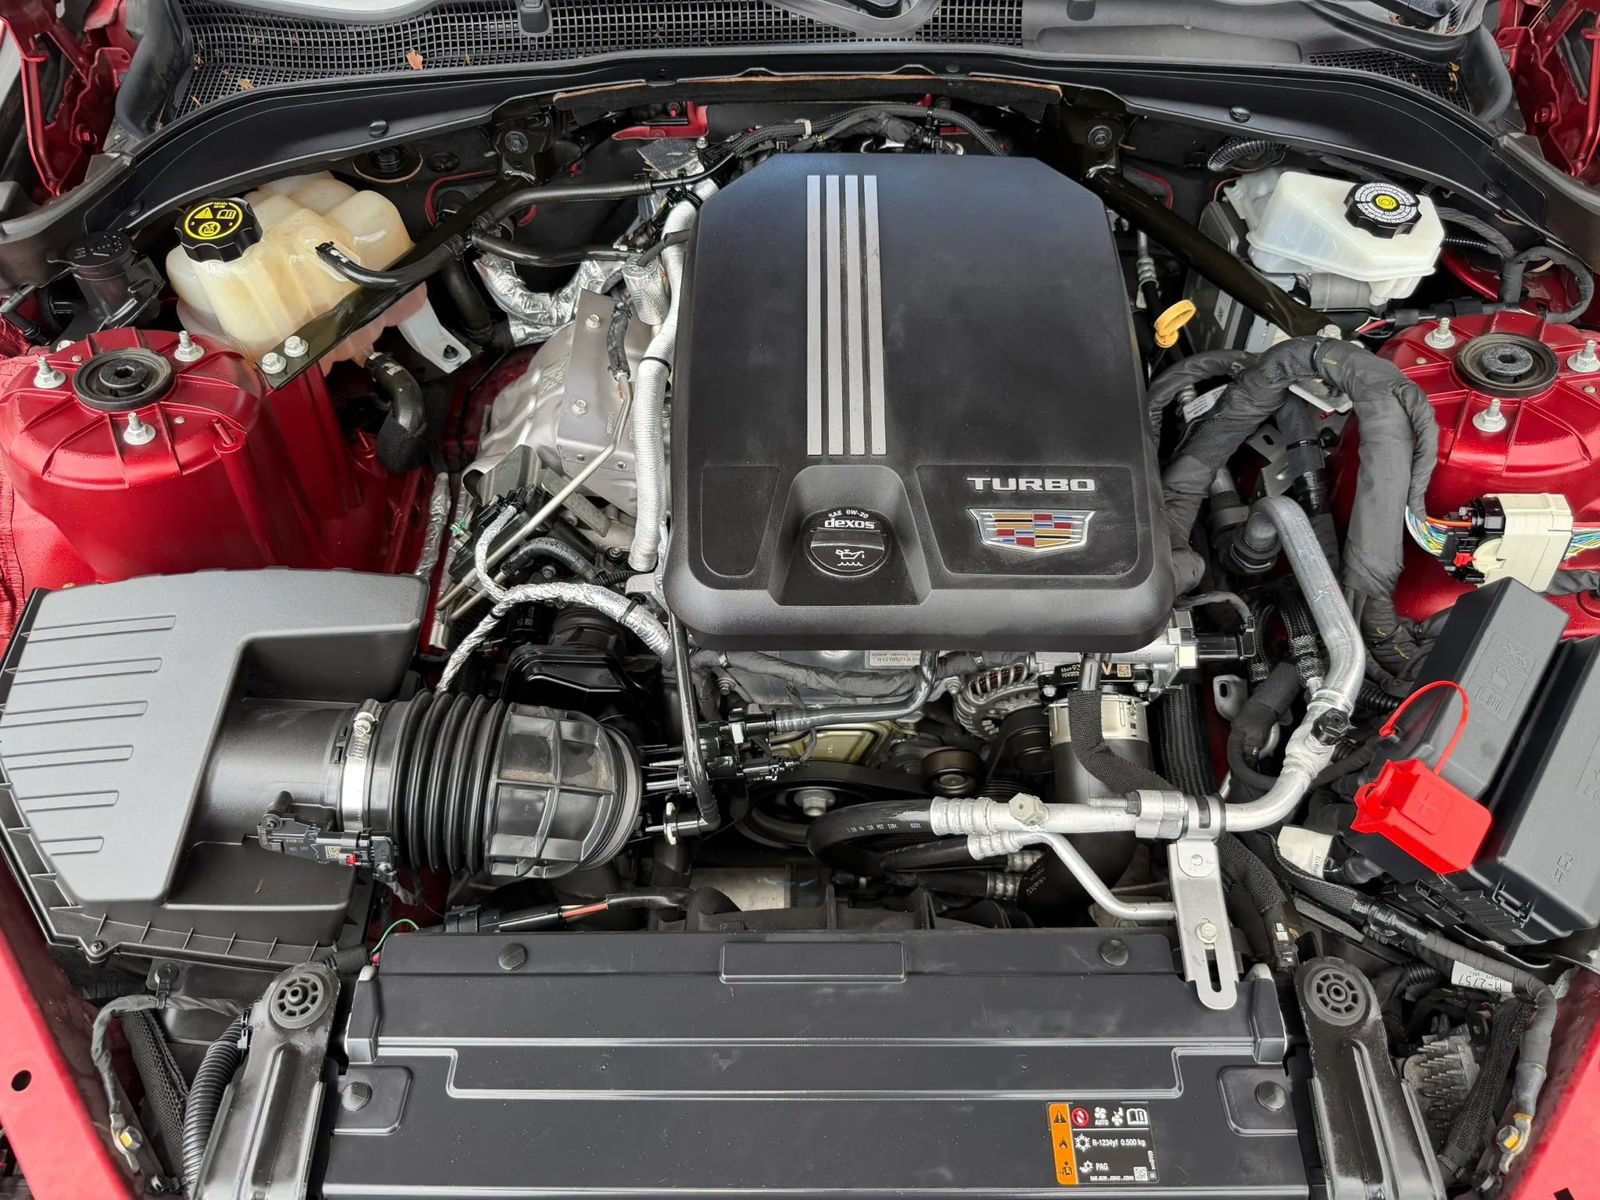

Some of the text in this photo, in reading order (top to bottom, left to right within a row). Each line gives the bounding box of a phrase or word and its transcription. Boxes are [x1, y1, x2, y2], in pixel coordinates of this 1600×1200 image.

[966, 477, 1096, 491] TURBO
[828, 509, 869, 519] SAE 0W-20
[824, 517, 876, 529] dexos
[1092, 1138, 1146, 1148] R-1234yf 0.500 kg
[1095, 1162, 1109, 1171] PAG
